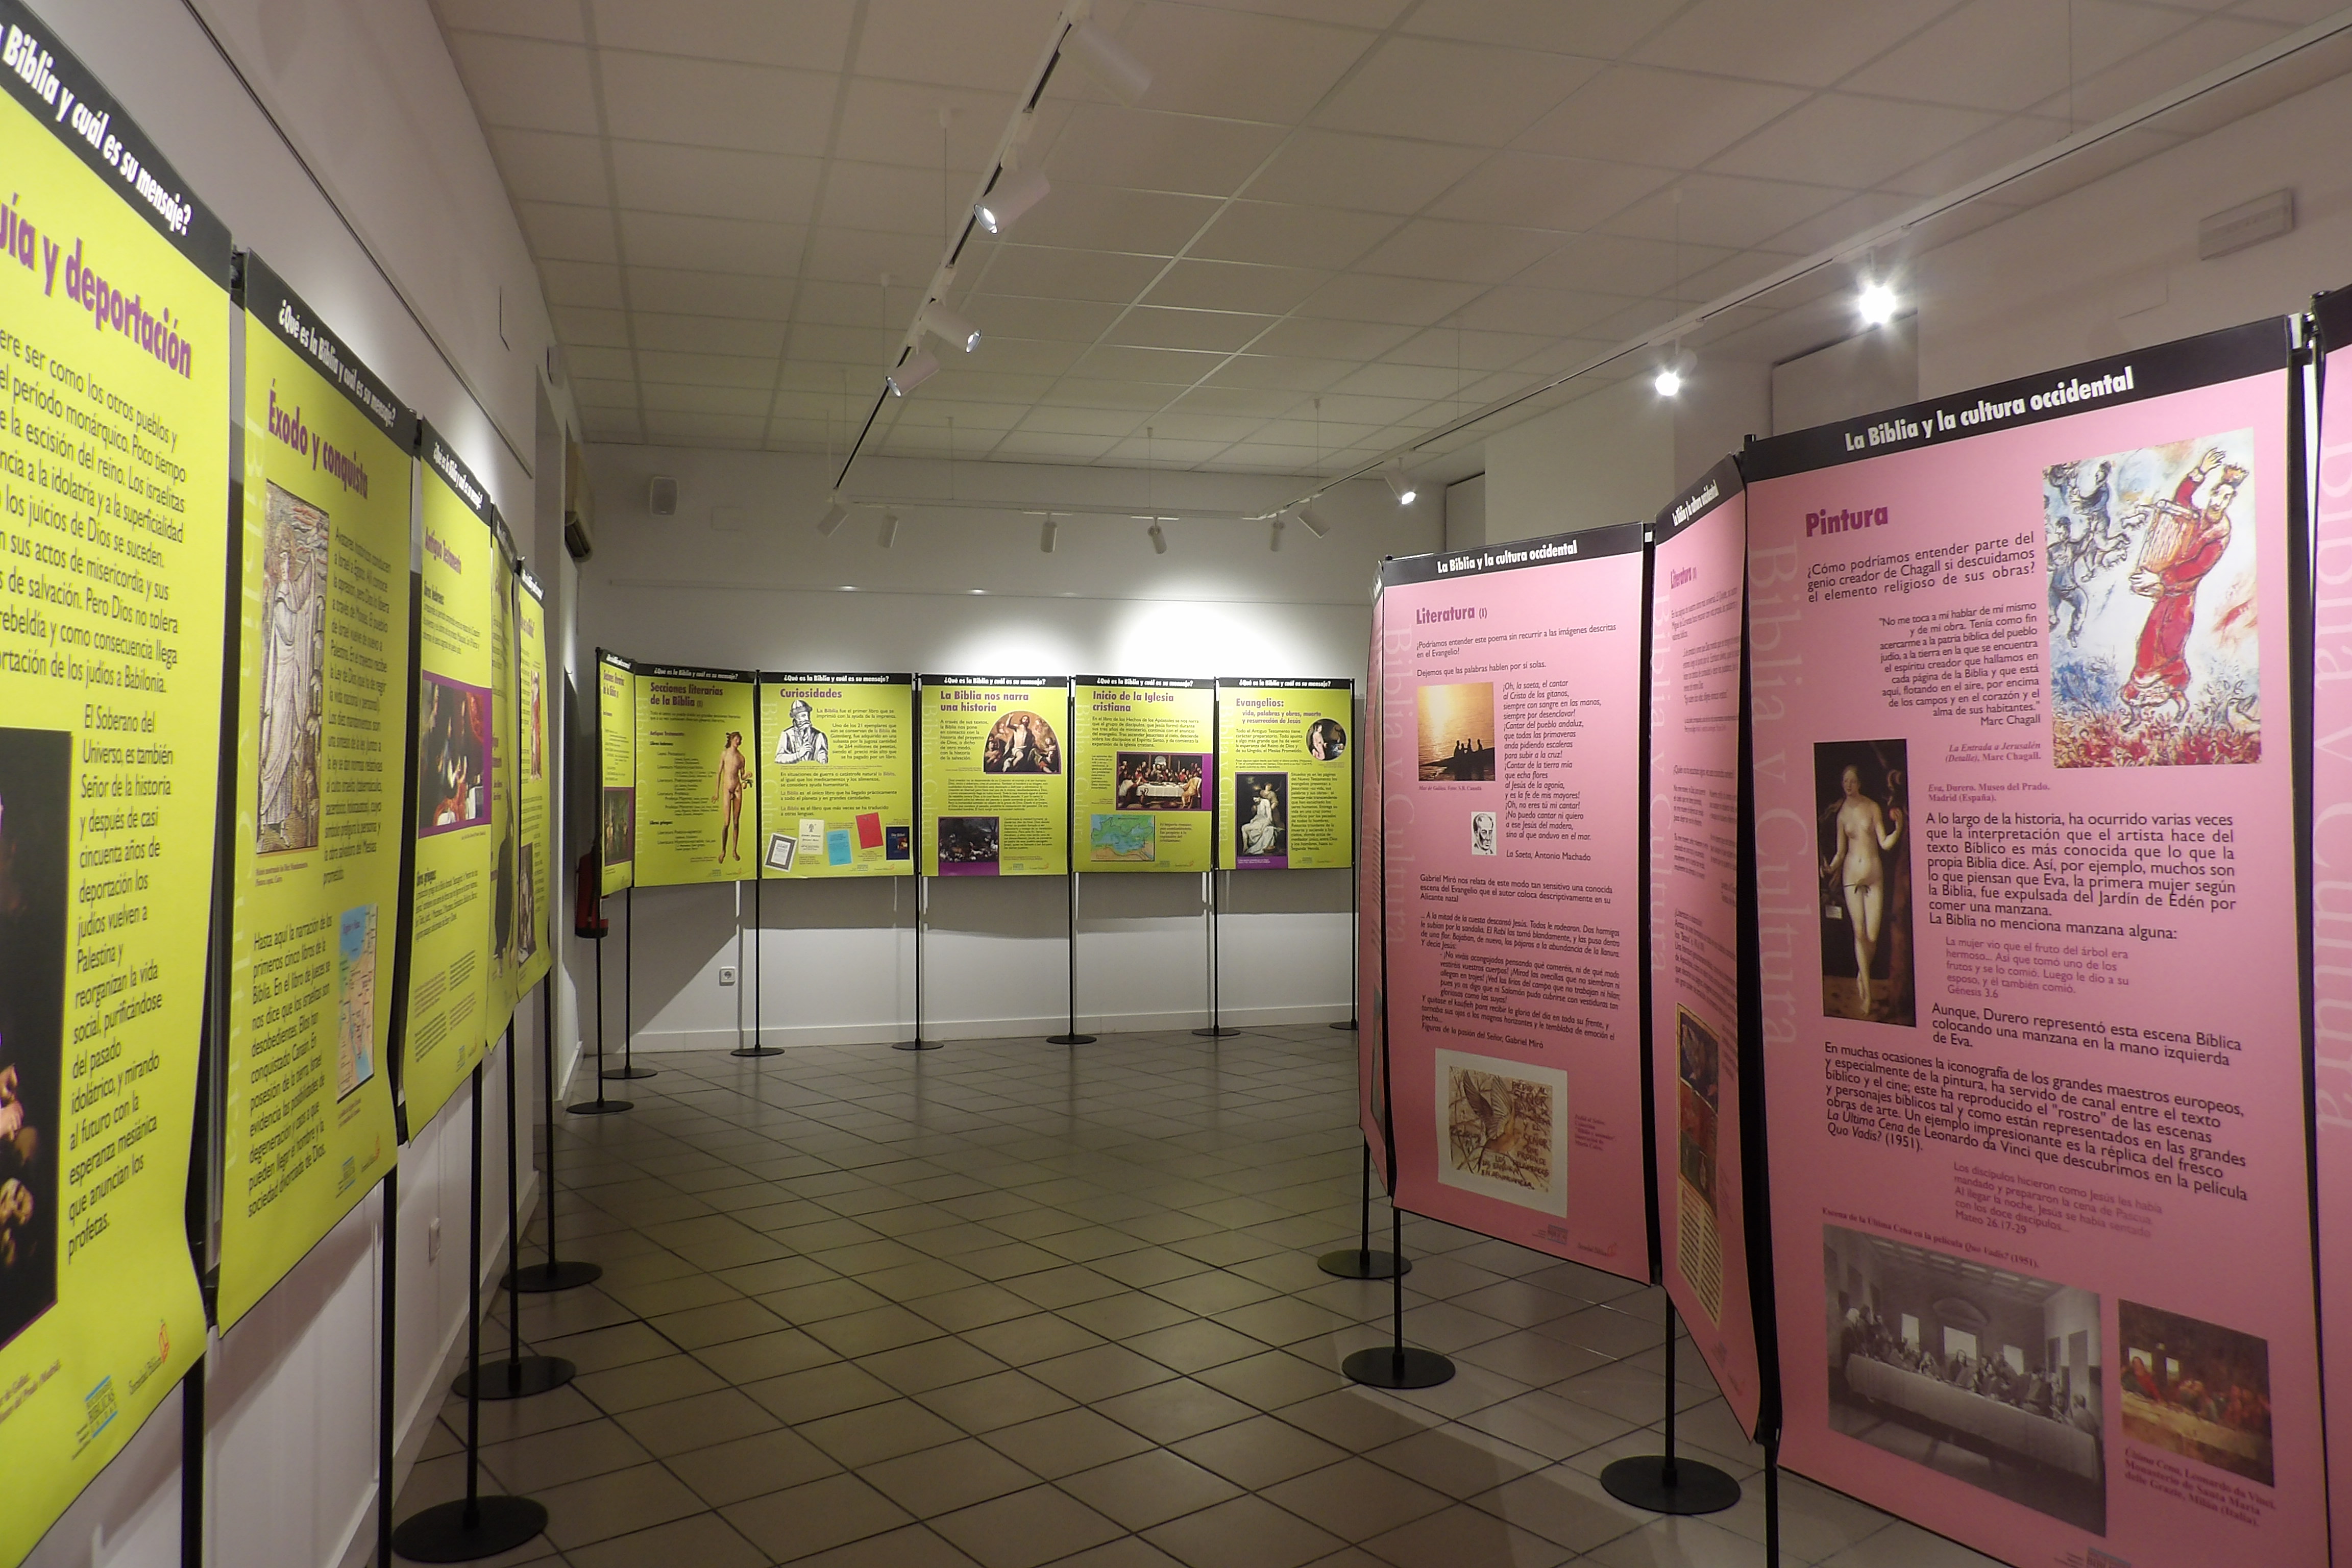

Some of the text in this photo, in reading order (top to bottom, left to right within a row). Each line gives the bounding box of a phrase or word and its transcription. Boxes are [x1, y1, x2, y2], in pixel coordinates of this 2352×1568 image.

[3, 25, 192, 235] Biblia y cuál es su mensaje?
[42, 235, 192, 379] y deportación
[26, 345, 177, 449] ser como los otros pueblos y
[1845, 366, 2134, 451] La Biblia y la cultura occidental
[269, 378, 307, 456] Éxodo
[312, 432, 321, 470] y
[323, 441, 368, 500] conquista
[7, 487, 163, 568] los juicios de Dios se suceden.
[1806, 507, 1888, 537] Pintura
[1437, 540, 1577, 573] La Biblia y la cultura occidental
[1808, 531, 2033, 578] ¿Cómo podríamos entender parte del
[1808, 550, 2034, 592] genio creador de Chagall si descuidamos
[1809, 561, 2035, 602] el elemento religioso de sus obras?
[1416, 607, 1475, 624] Literatura
[1417, 670, 1442, 678] Dejemos
[1464, 666, 1487, 675] palabras
[651, 682, 723, 695] Secciones literarias
[651, 694, 659, 704] de
[663, 695, 670, 705] la
[673, 696, 695, 706] Biblia
[780, 688, 842, 698] Curiosidades
[941, 691, 951, 699] La
[954, 690, 981, 700] Biblia
[1093, 691, 1173, 702] Inicio de la Iglesia
[961, 702, 996, 712] historia
[1093, 702, 1131, 712] cristiana
[1237, 698, 1284, 708] Evangelios:
[85, 703, 154, 733] El Soberano del
[1981, 714, 2040, 726] Marc Chagall
[1926, 813, 2233, 829] A lo largo de la historia, ha ocurrido varias veces
[1515, 850, 1532, 859] Saeta,
[1562, 852, 1590, 861] Machado
[1948, 985, 1998, 998] Génesis 3.6
[1828, 1122, 1922, 1152] Quo Vadis? (1951).
[68, 1213, 110, 1265] profetas.
